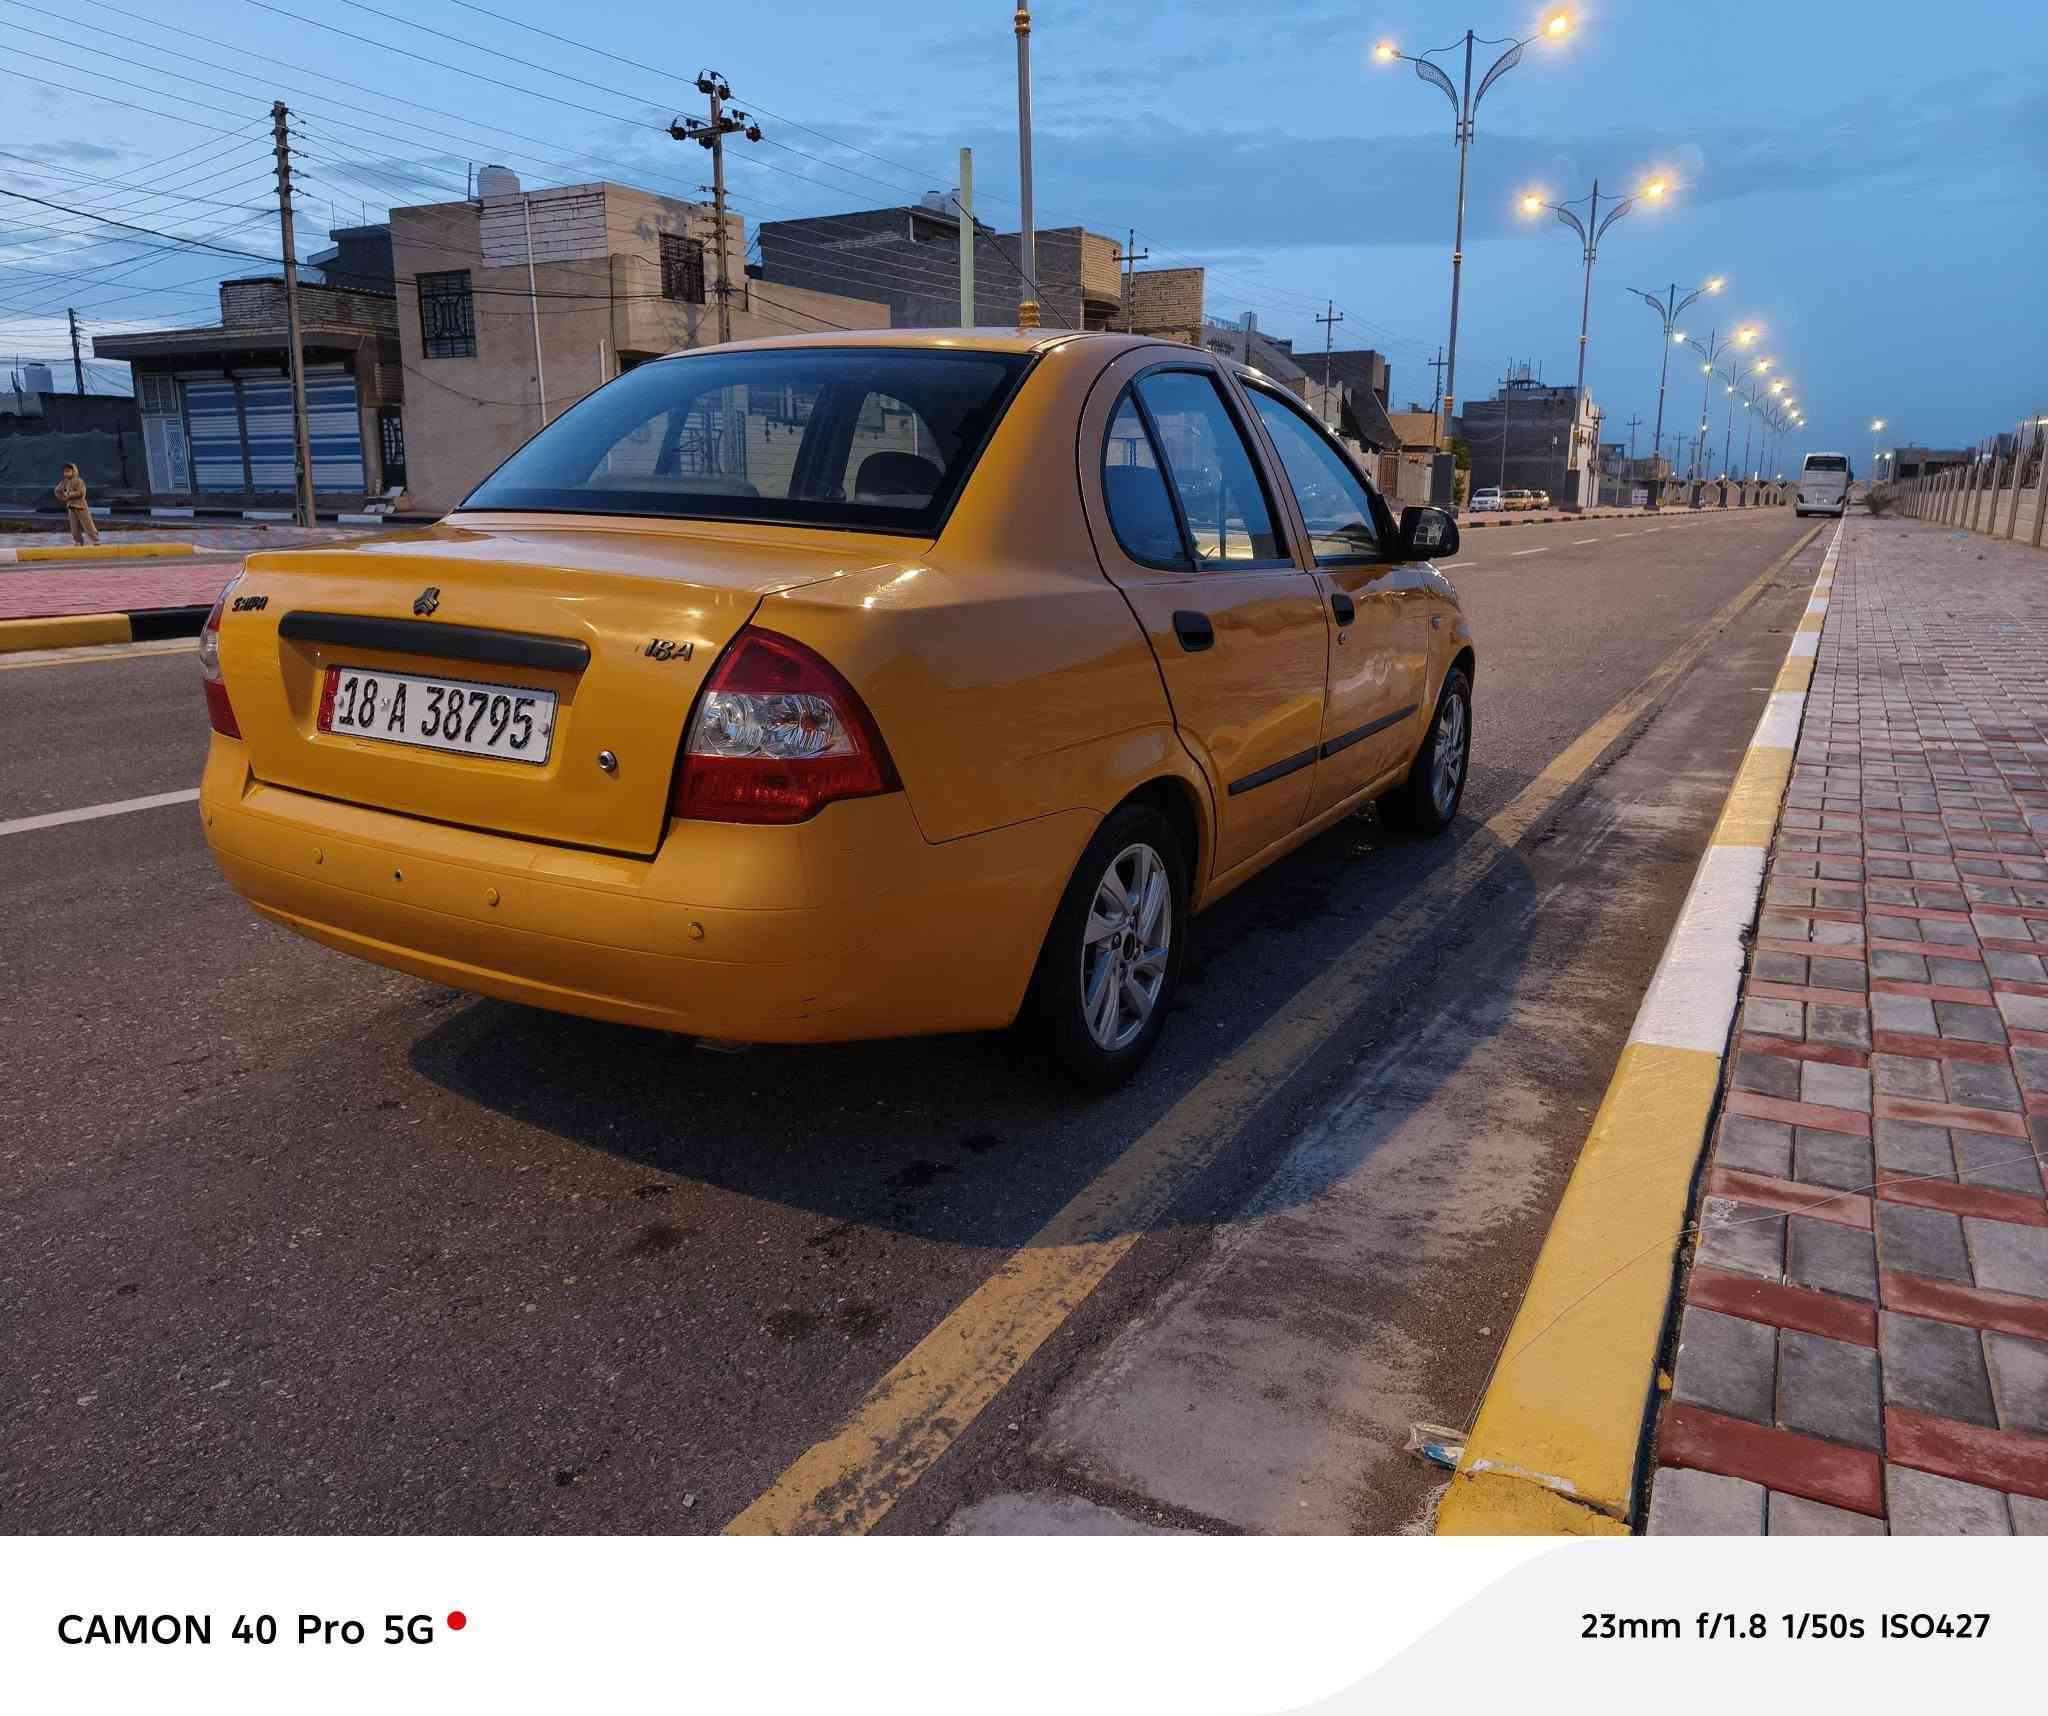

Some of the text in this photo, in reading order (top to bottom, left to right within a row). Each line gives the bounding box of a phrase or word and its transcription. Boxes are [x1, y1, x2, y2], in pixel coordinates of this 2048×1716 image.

[338, 677, 378, 729] 18
[387, 682, 407, 733] A
[421, 686, 536, 749] 38795
